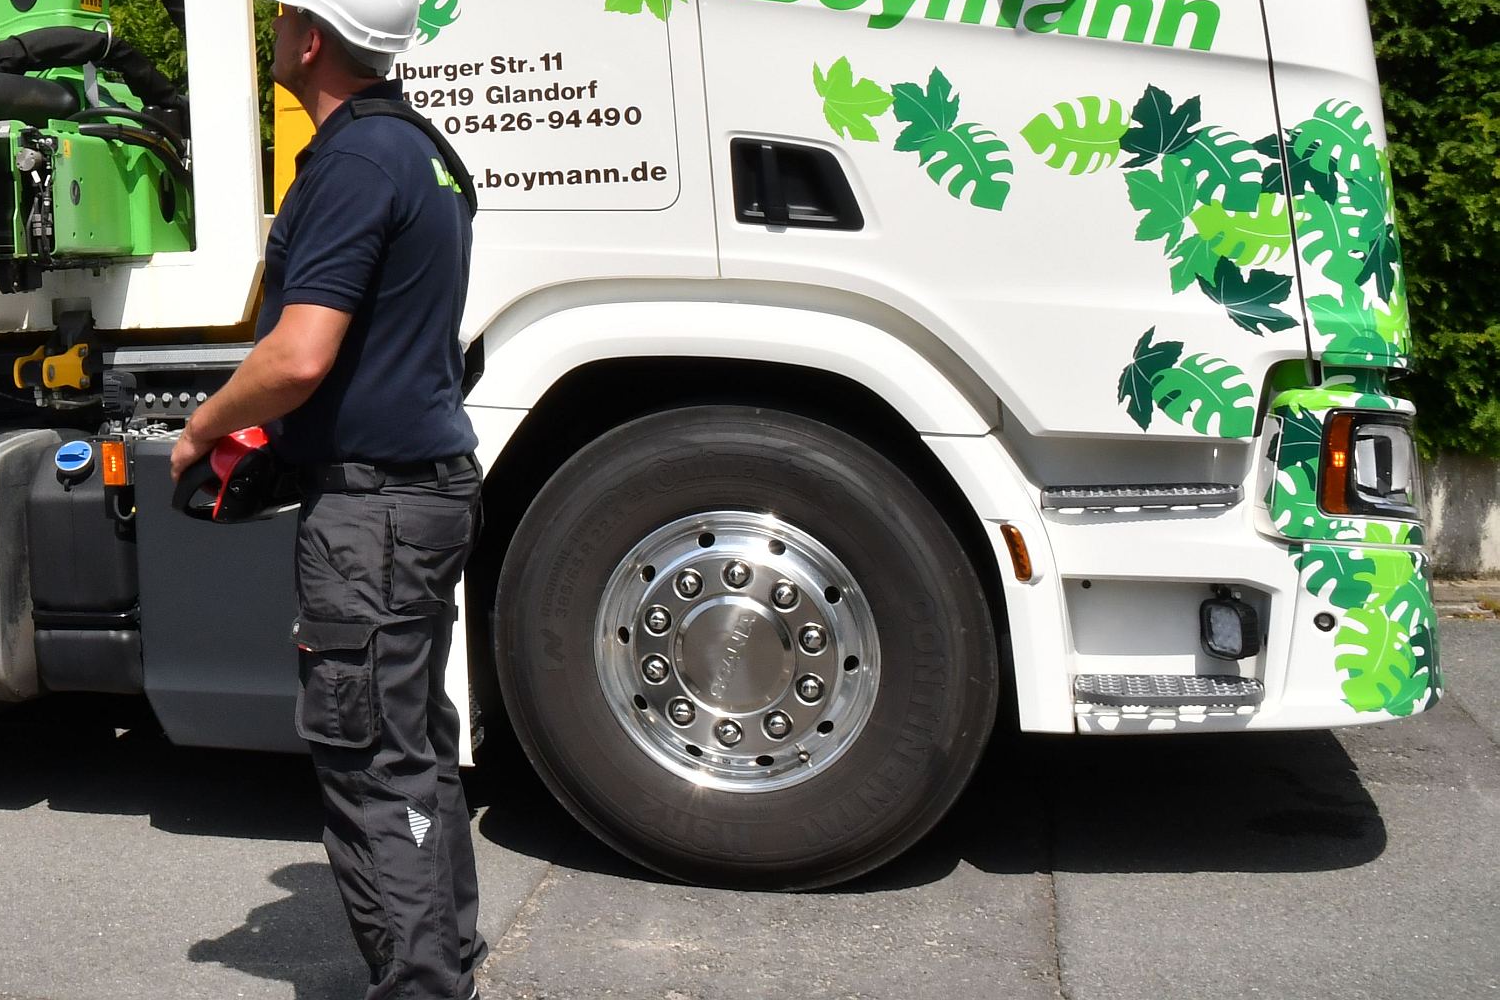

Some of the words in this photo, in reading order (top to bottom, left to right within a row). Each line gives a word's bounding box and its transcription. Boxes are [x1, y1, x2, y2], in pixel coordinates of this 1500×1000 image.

[490, 55, 535, 75] Str.
[540, 52, 563, 71] 11
[485, 80, 598, 105] Glandorf
[471, 161, 668, 191] .boymann.de
